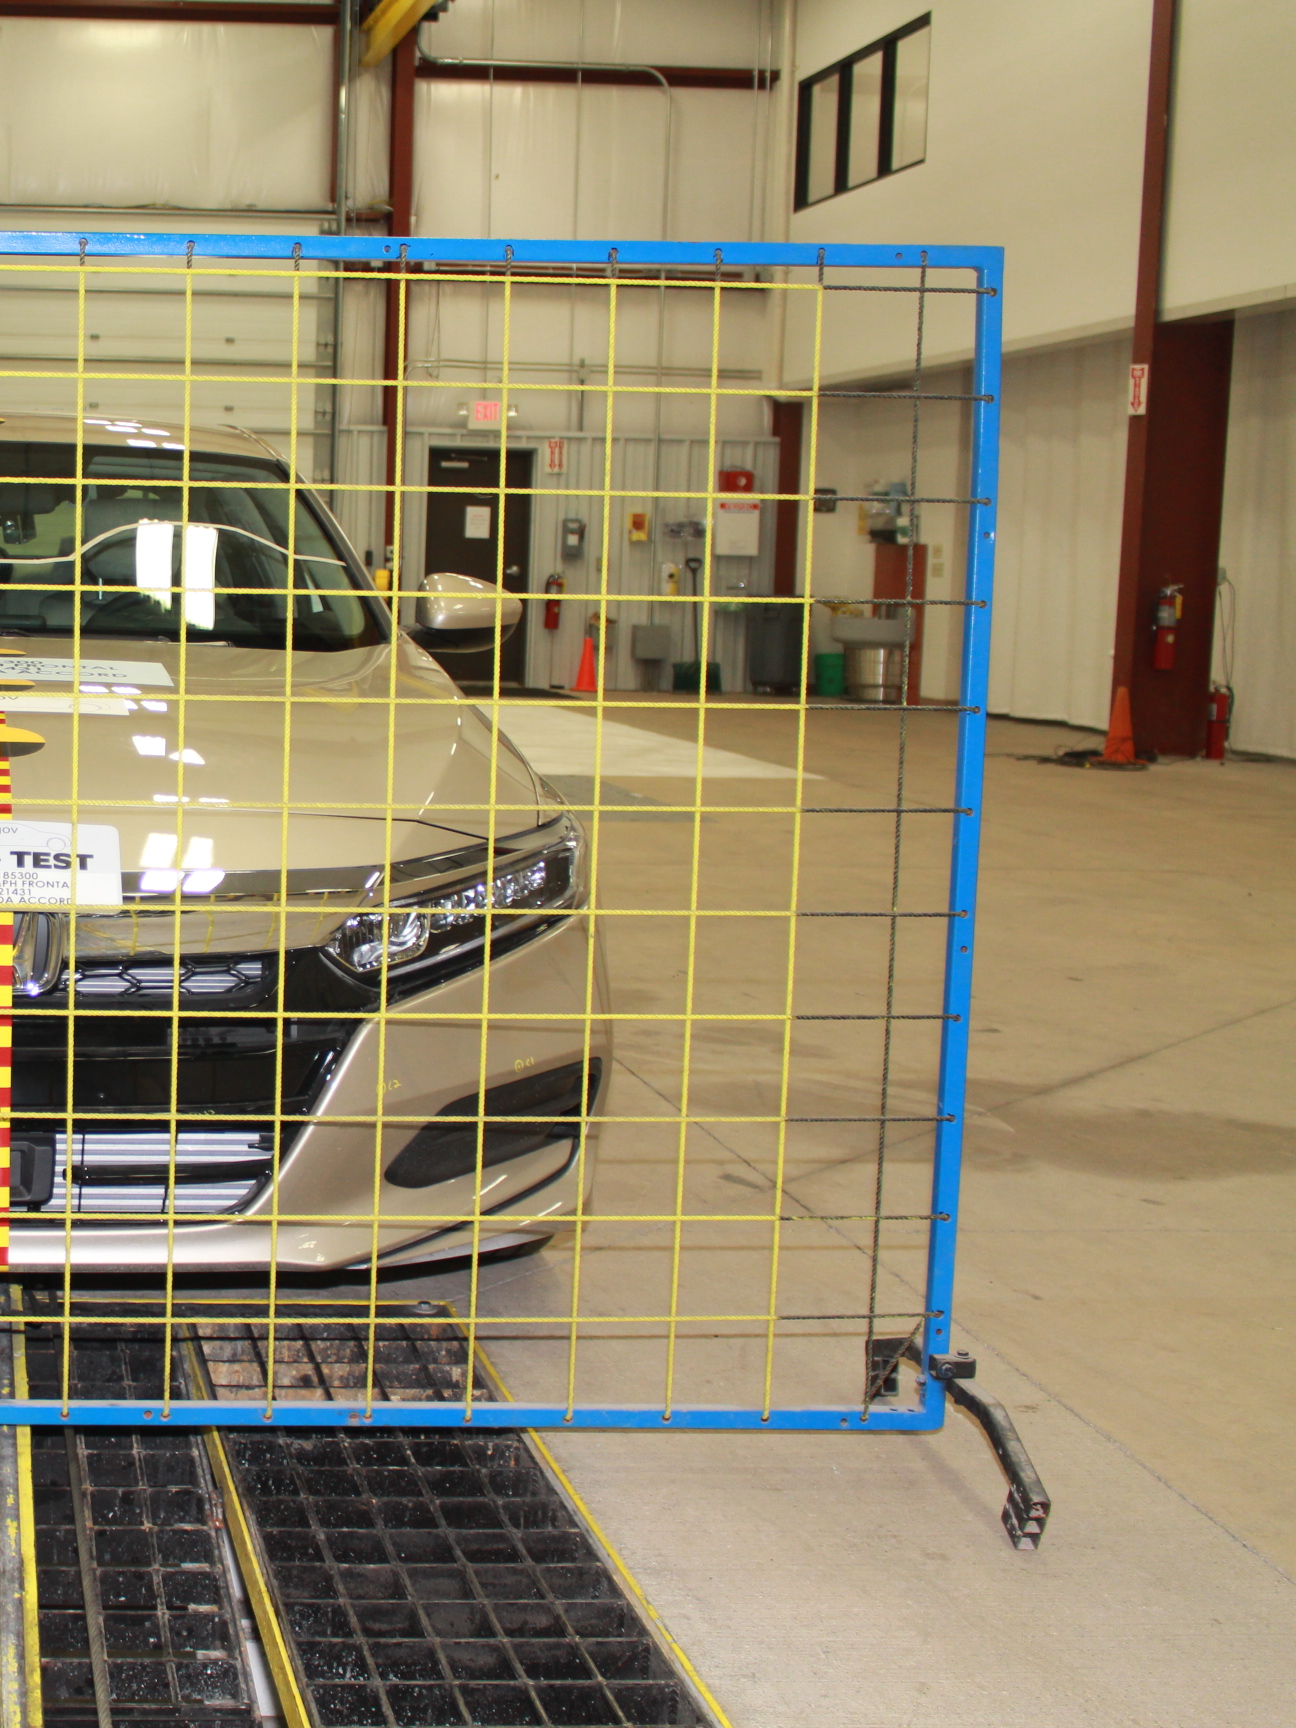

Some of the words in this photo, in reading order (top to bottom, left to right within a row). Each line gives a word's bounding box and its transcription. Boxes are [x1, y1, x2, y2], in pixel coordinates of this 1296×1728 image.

[475, 401, 500, 421] EXIT
[16, 670, 128, 678] ACCORD
[9, 850, 94, 871] TEST
[22, 880, 73, 889] FRONTA
